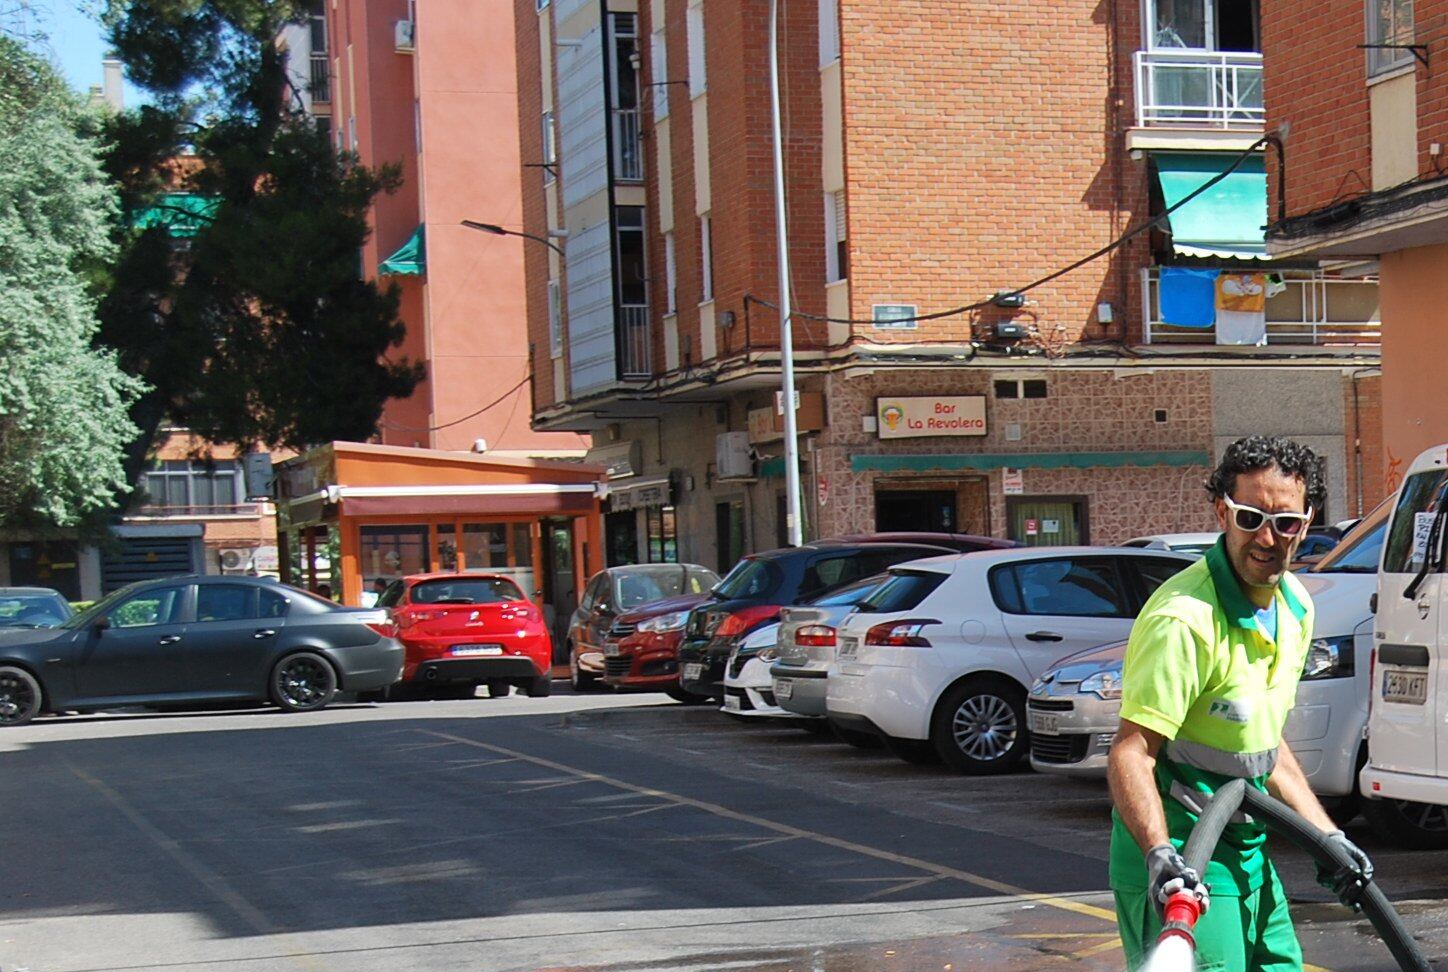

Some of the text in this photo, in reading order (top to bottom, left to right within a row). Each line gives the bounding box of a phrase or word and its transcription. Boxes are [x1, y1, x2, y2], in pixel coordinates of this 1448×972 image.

[934, 403, 956, 414] Bar
[908, 417, 984, 429] La Revolera
